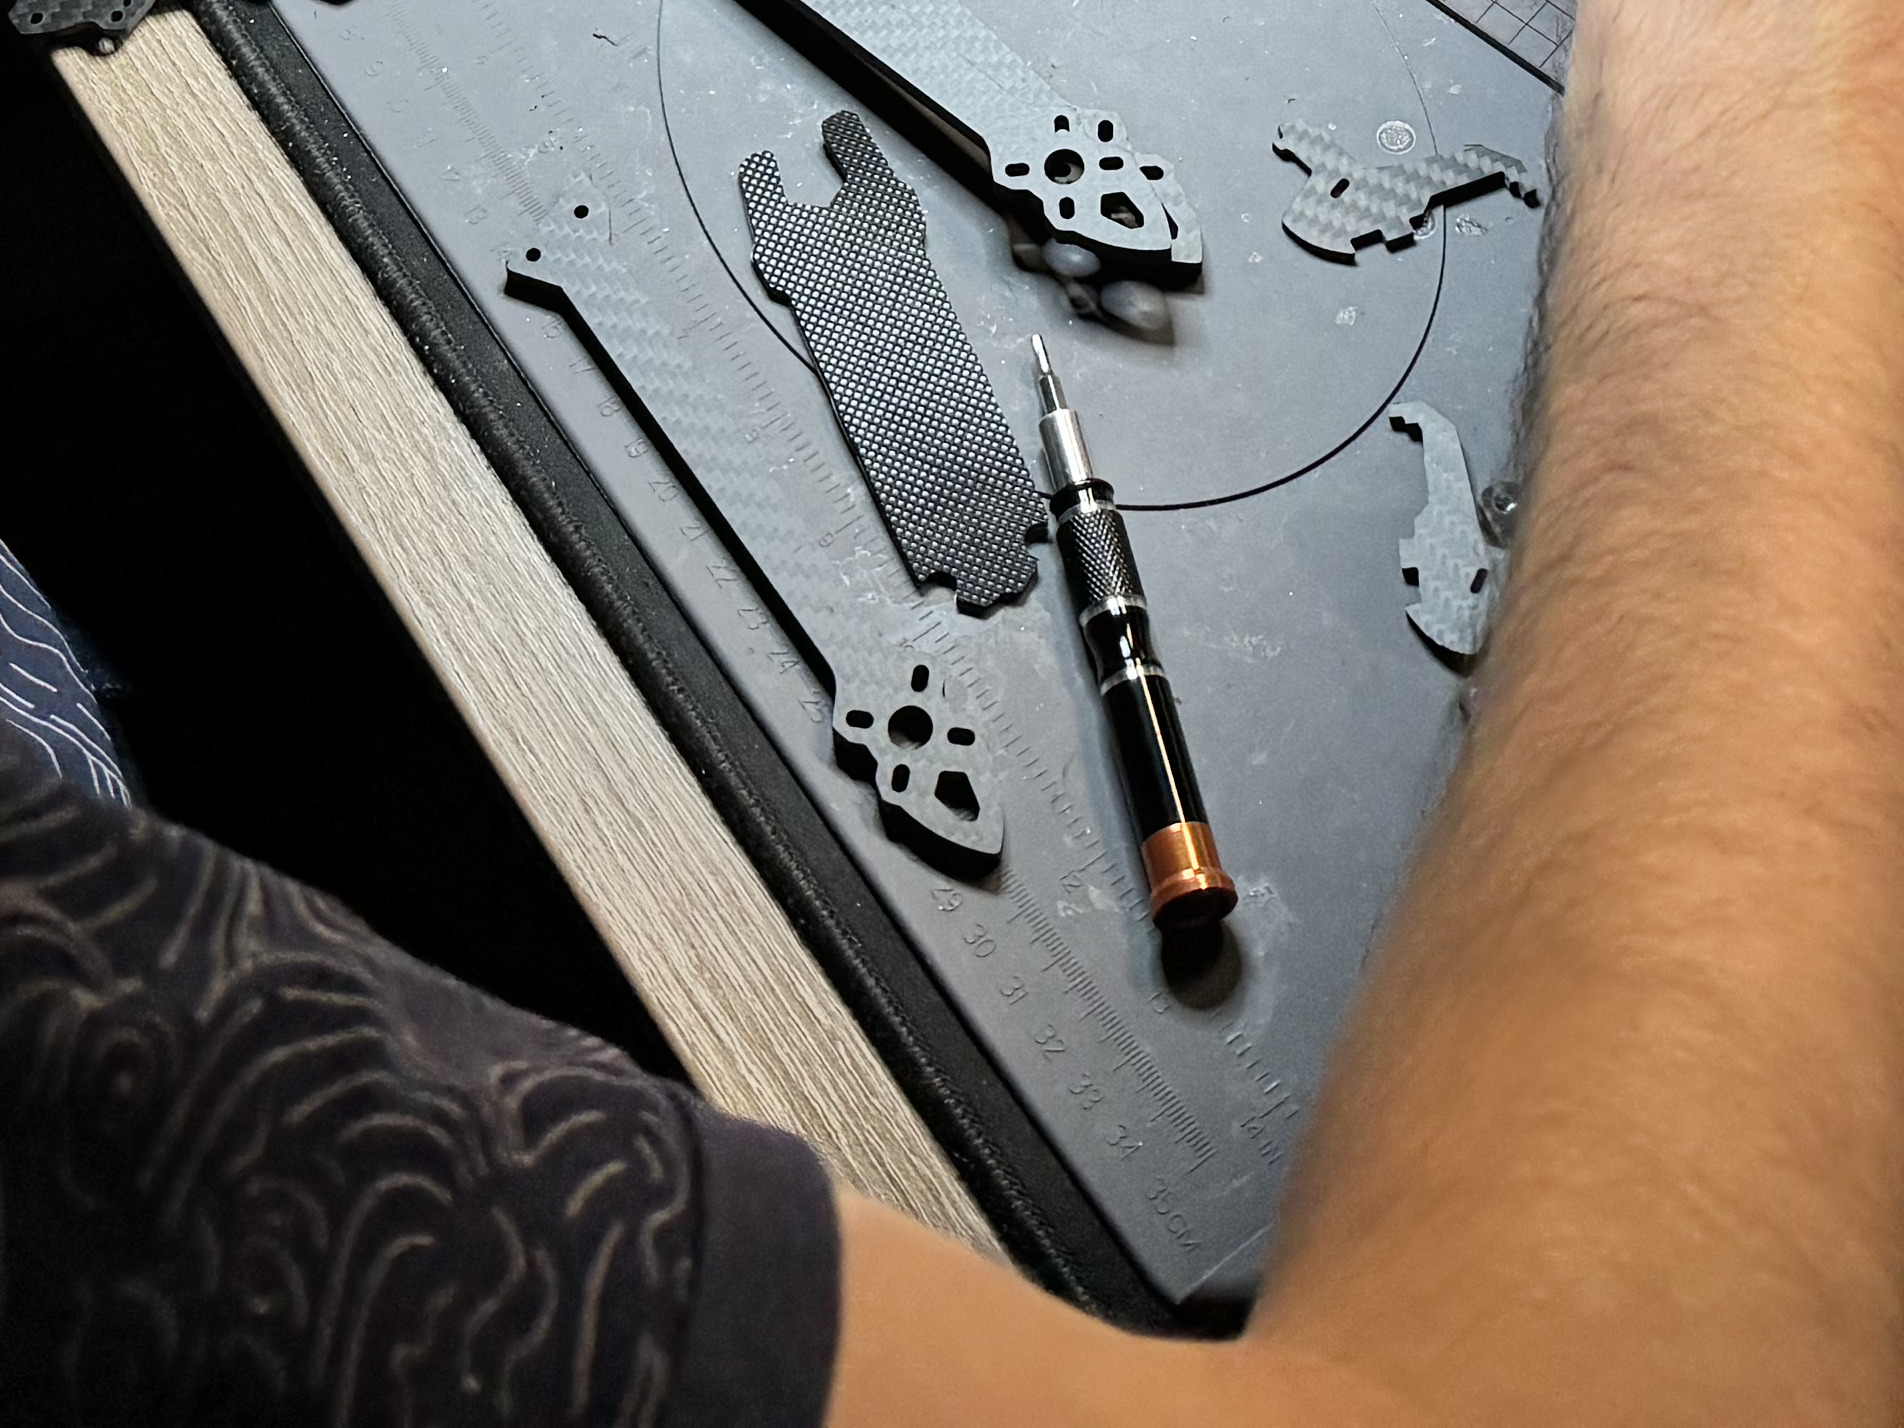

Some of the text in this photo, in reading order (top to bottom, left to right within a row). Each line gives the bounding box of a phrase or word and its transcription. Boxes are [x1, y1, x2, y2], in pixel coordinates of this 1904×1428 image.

[930, 885, 964, 913] 29
[960, 922, 997, 959] 30
[998, 975, 1031, 1006] 31
[1032, 1023, 1067, 1063] 32
